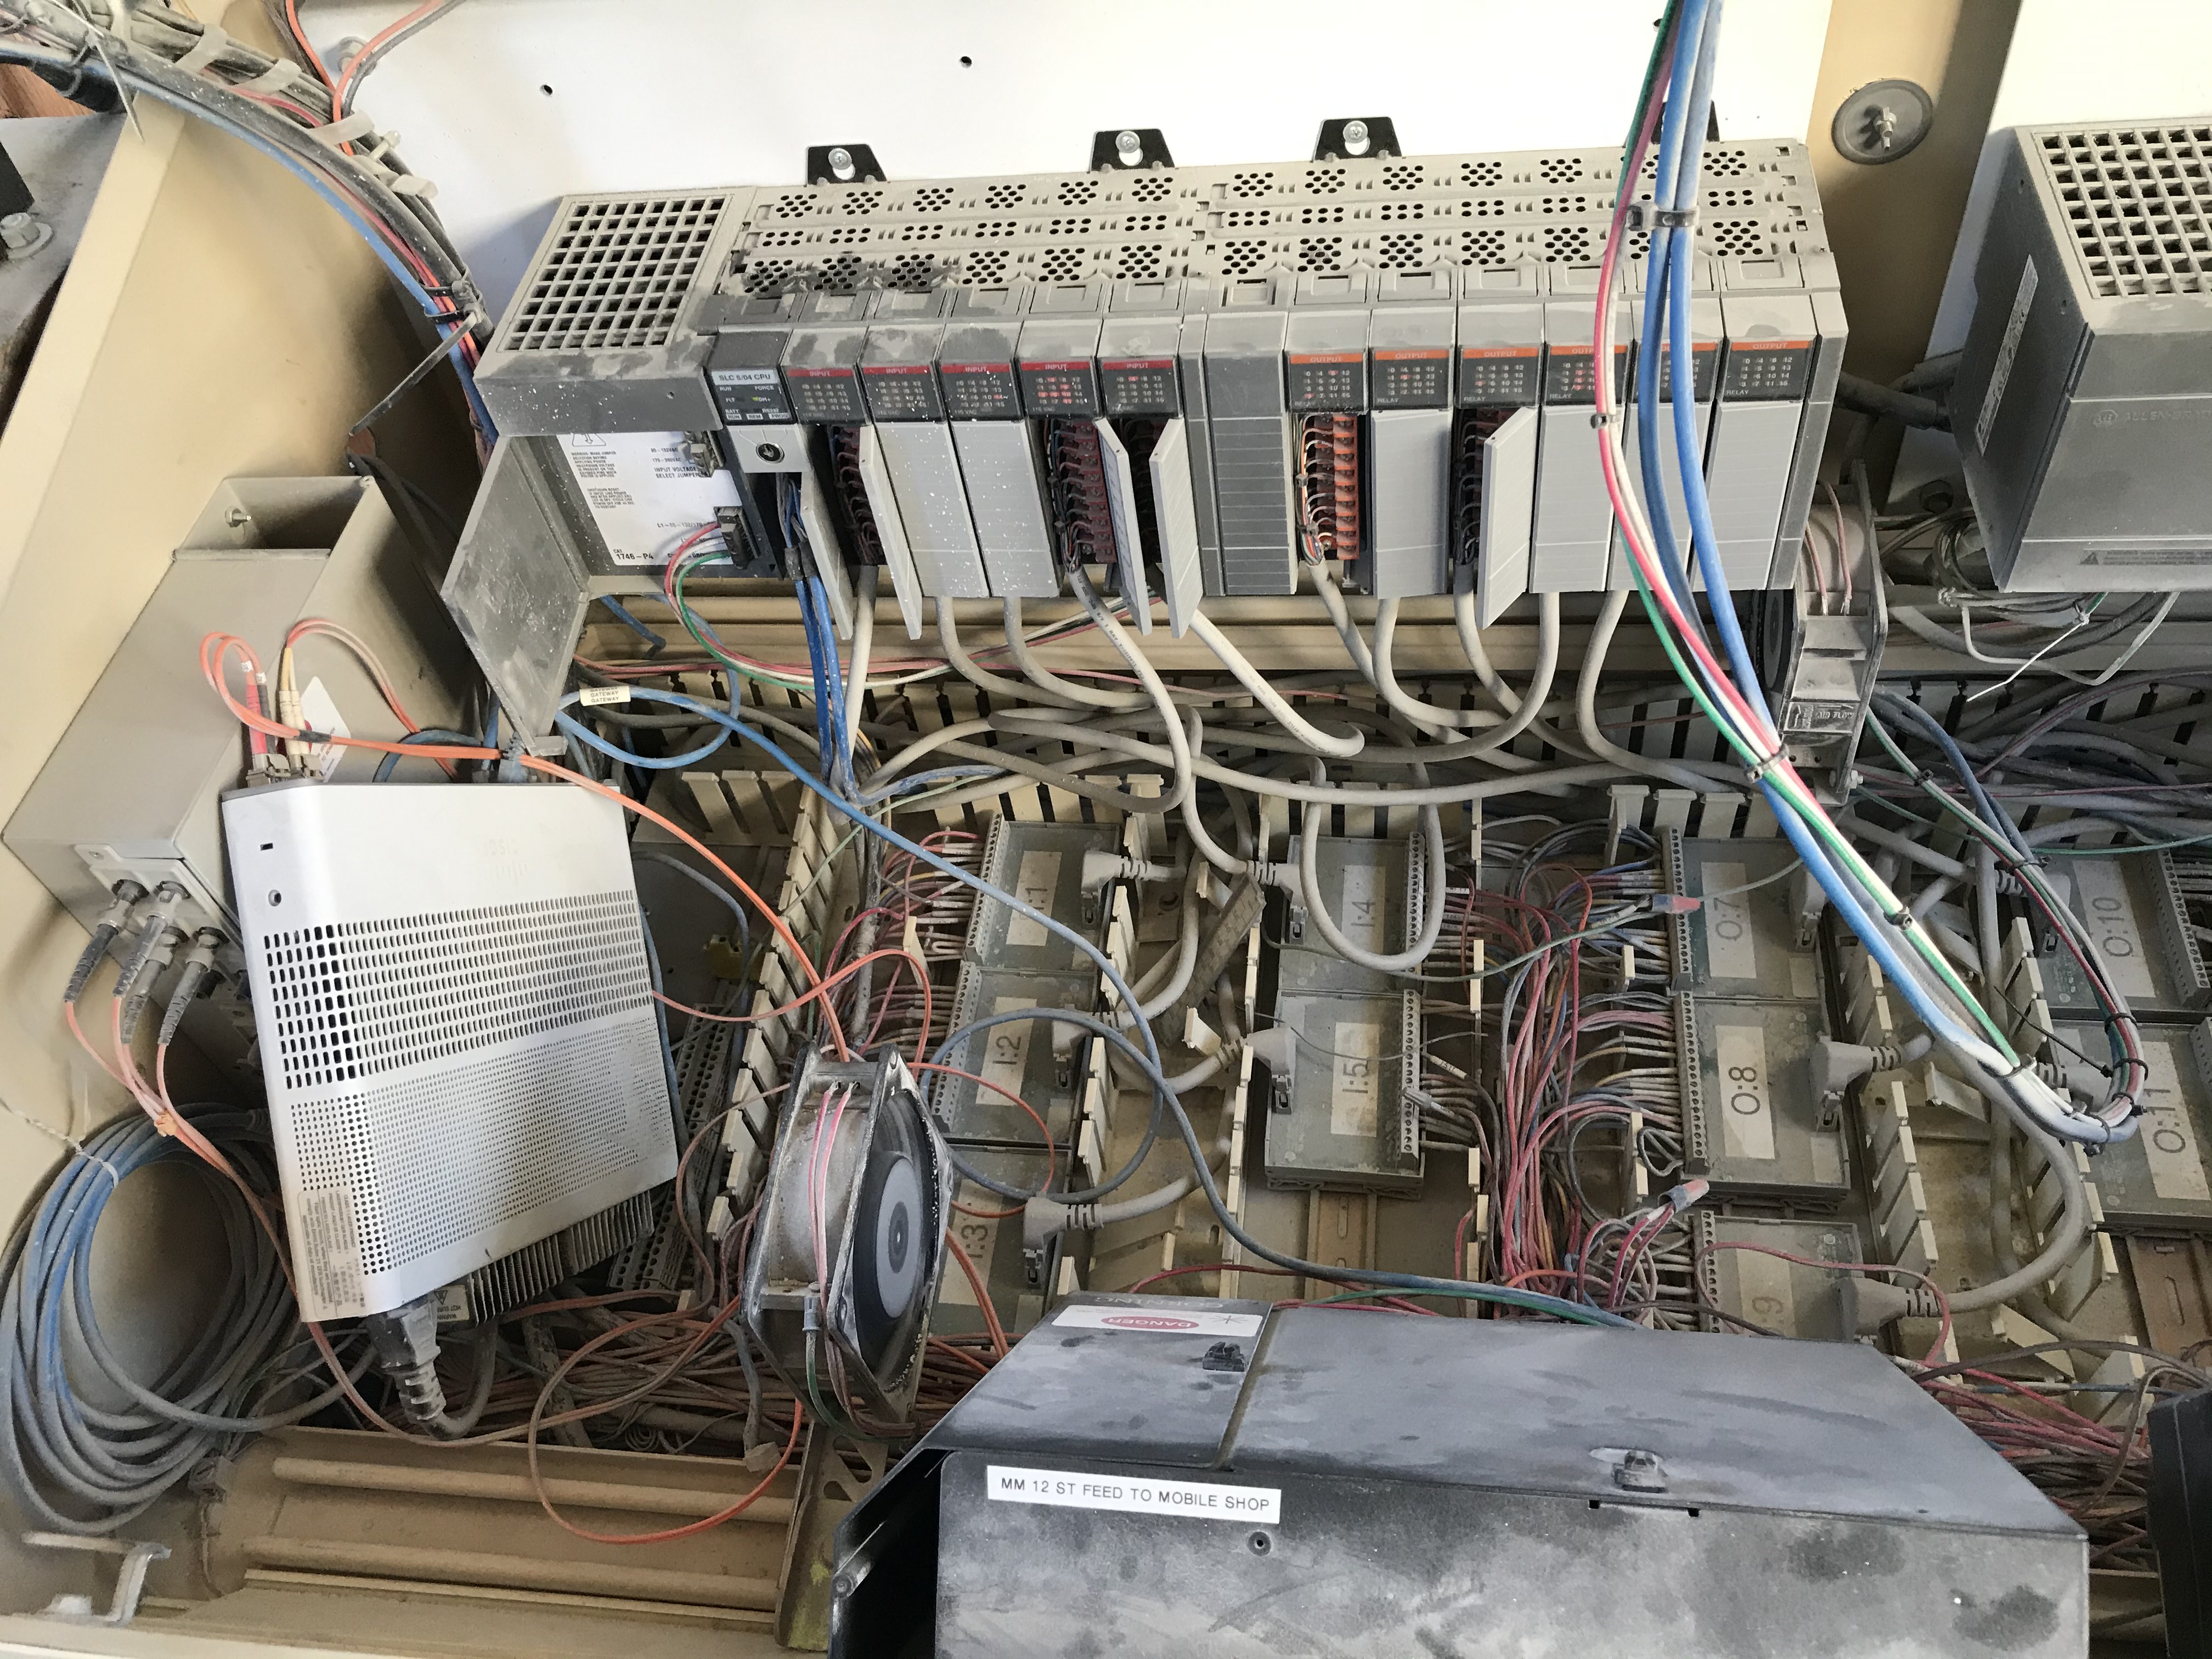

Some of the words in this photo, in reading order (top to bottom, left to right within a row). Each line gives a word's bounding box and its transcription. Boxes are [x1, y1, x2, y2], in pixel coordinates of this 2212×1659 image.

[1108, 1318, 1192, 1327] DANGER
[1002, 1477, 1025, 1491] MM
[1034, 1480, 1049, 1493] 12
[1056, 1482, 1076, 1494] ST
[1083, 1485, 1122, 1499] FEED
[1131, 1488, 1152, 1502] TO
[1159, 1491, 1217, 1507] MOBILE
[1225, 1496, 1269, 1511] SHOP
